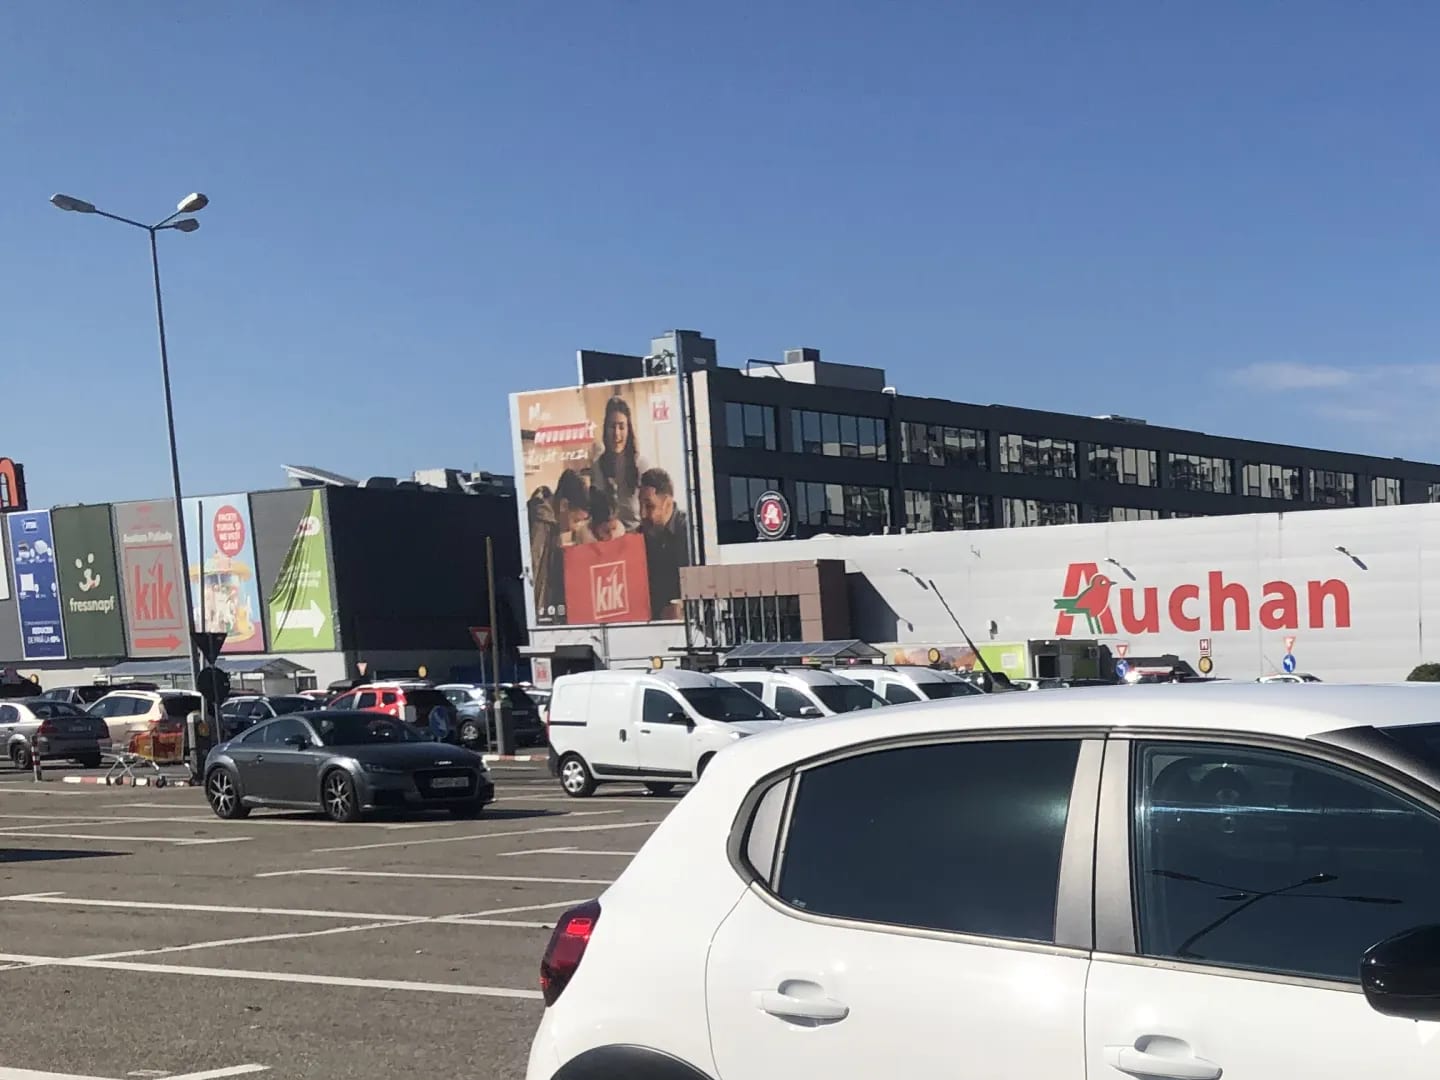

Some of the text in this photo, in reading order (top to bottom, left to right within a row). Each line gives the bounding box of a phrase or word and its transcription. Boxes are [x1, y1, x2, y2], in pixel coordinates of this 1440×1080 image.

[70, 595, 114, 614] fressnapf
[596, 566, 625, 612] kik
[1054, 562, 1351, 636] Auchan
